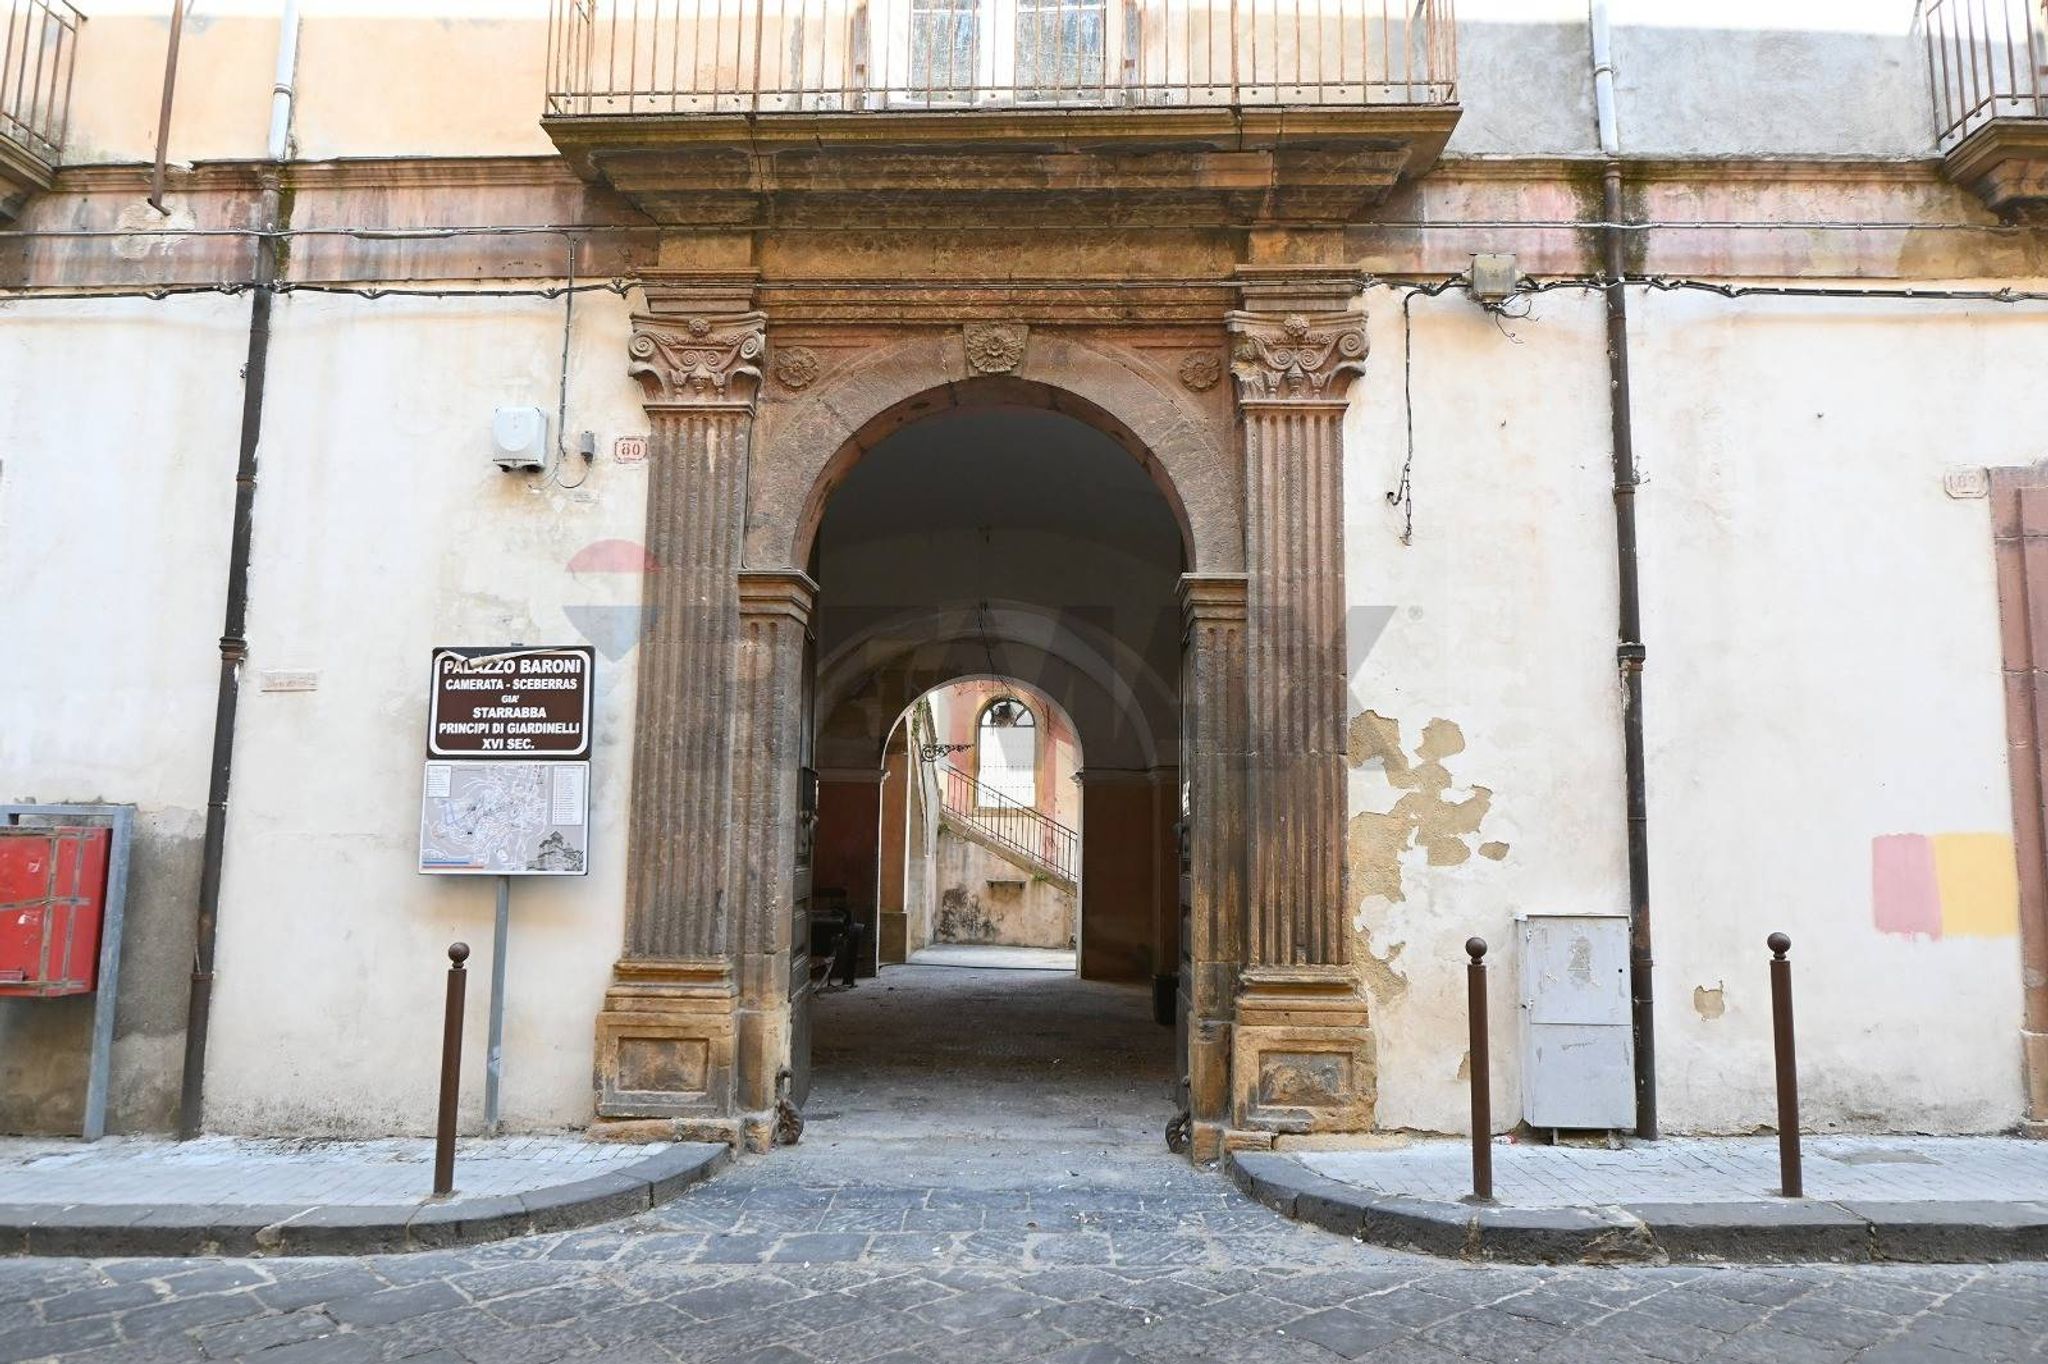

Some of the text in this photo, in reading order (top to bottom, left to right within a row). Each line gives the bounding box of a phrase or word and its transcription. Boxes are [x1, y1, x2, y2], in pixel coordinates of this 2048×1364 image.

[621, 443, 640, 455] 80
[520, 659, 581, 673] BARONI
[445, 679, 504, 690] CAMERATA
[512, 678, 577, 689] SCEBERRAS
[472, 707, 547, 718] STARRABBA
[439, 723, 580, 734] PRINCIPI DI GIARDINELLI
[482, 739, 535, 749] XVI SEC.
